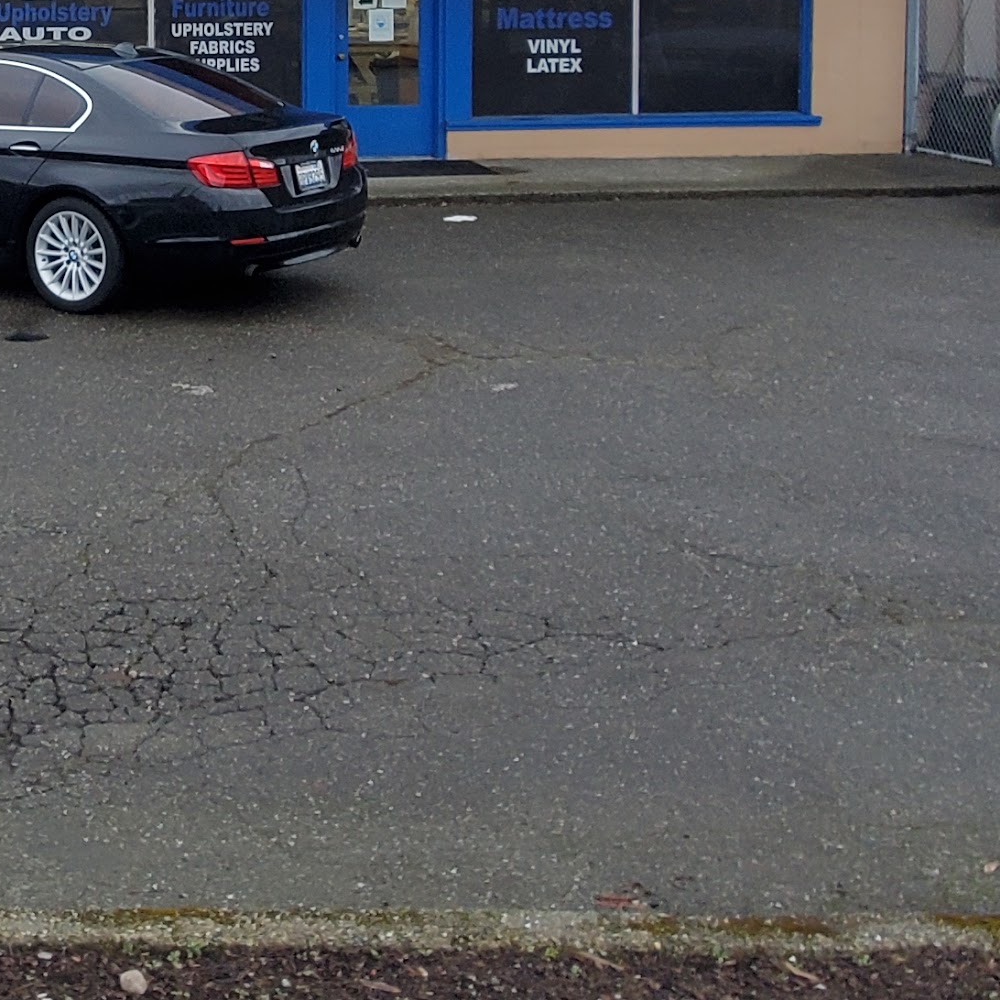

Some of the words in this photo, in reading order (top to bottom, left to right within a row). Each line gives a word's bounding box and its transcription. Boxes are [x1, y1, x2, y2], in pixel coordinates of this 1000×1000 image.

[496, 6, 614, 30] Mattress
[171, 21, 275, 38] UPHOLSTERY
[189, 40, 256, 55] FABRICS
[527, 38, 582, 54] VINYL
[195, 57, 261, 73] PPLIES
[526, 57, 583, 74] LATEX
